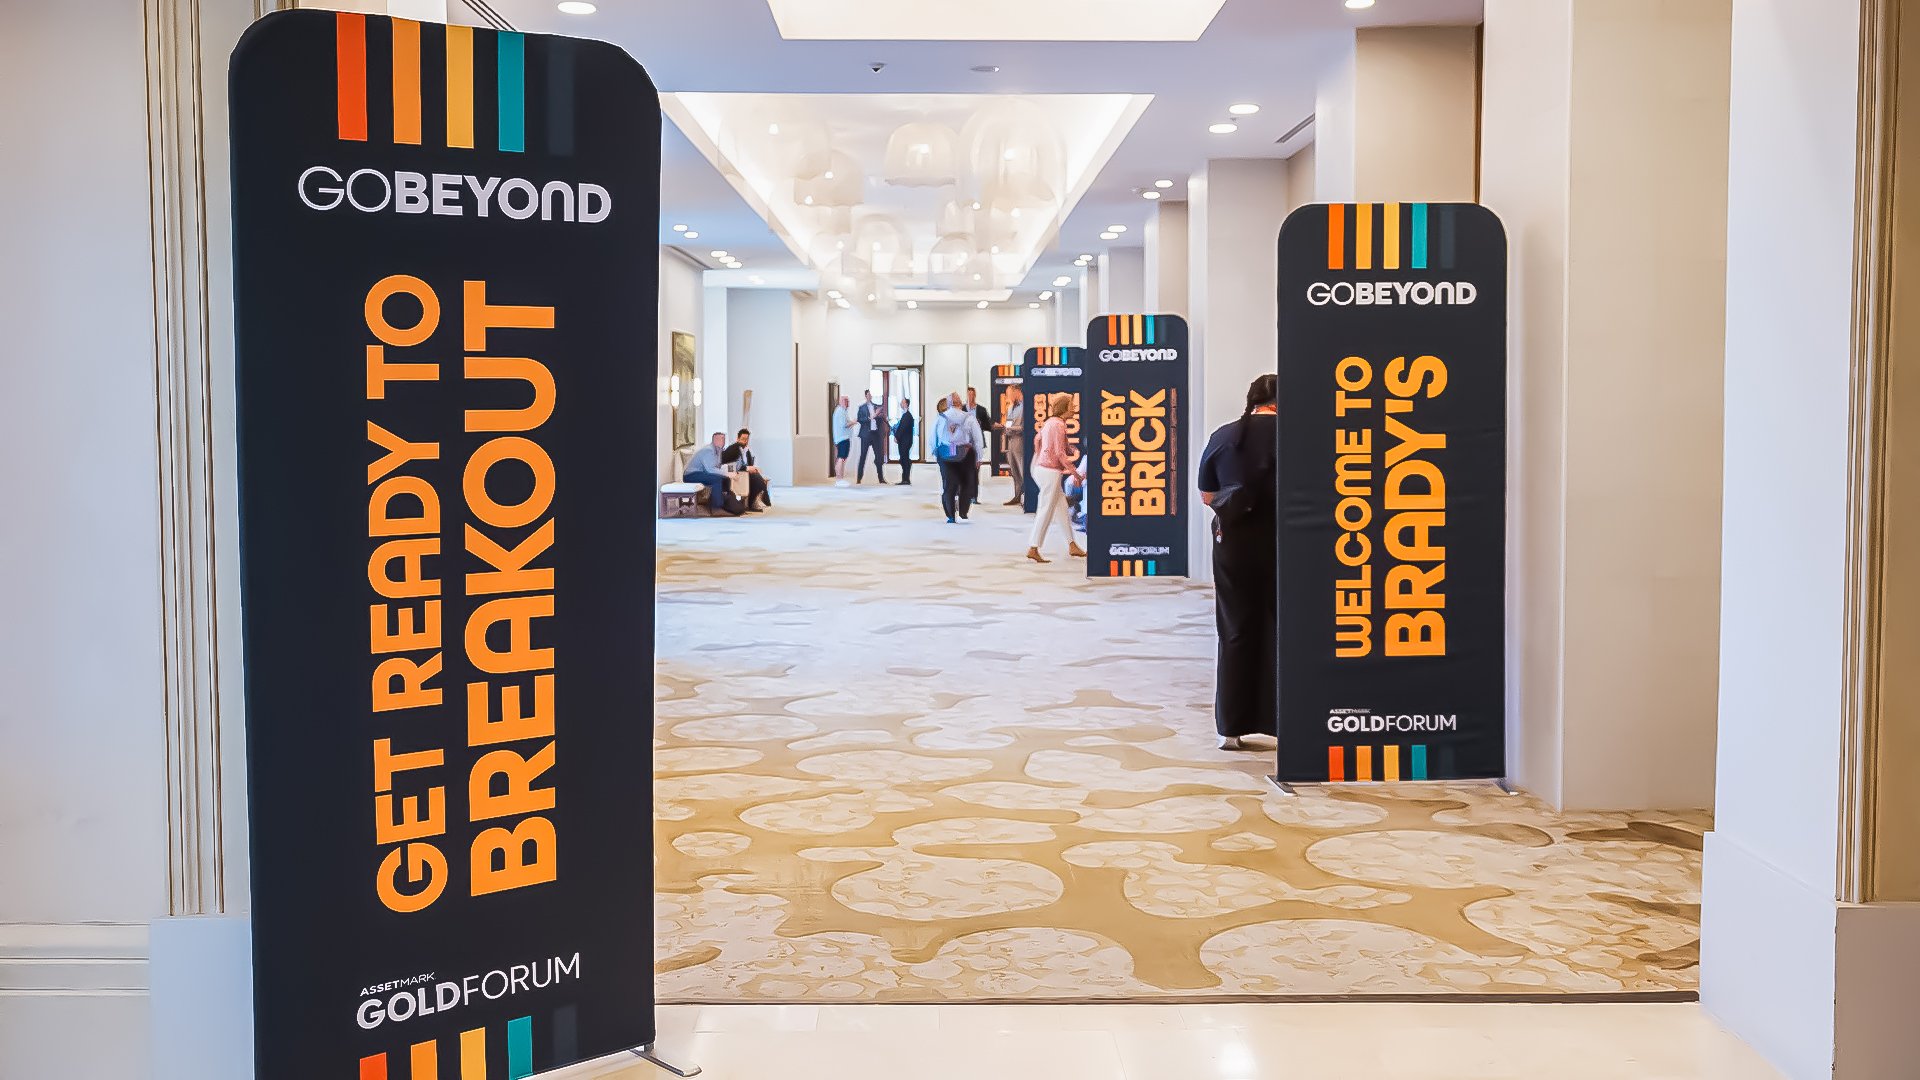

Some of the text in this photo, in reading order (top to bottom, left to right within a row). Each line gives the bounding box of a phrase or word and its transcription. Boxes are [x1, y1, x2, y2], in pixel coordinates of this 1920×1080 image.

[298, 166, 612, 223] GOBEYOND
[1306, 281, 1477, 305] GOBEYOND
[1101, 389, 1126, 426] BY
[1101, 432, 1126, 516] BRICK
[1129, 388, 1166, 516] BRICK
[1335, 356, 1373, 658] WELCOME TO
[1384, 355, 1448, 657] BRADY'S
[364, 274, 448, 913] GET READY TO
[463, 280, 557, 896] BREAKOUT
[1327, 714, 1457, 732] GOLDFORUM
[356, 952, 581, 1030] GOLDFORUM
[359, 971, 437, 997] ASSETMARK
